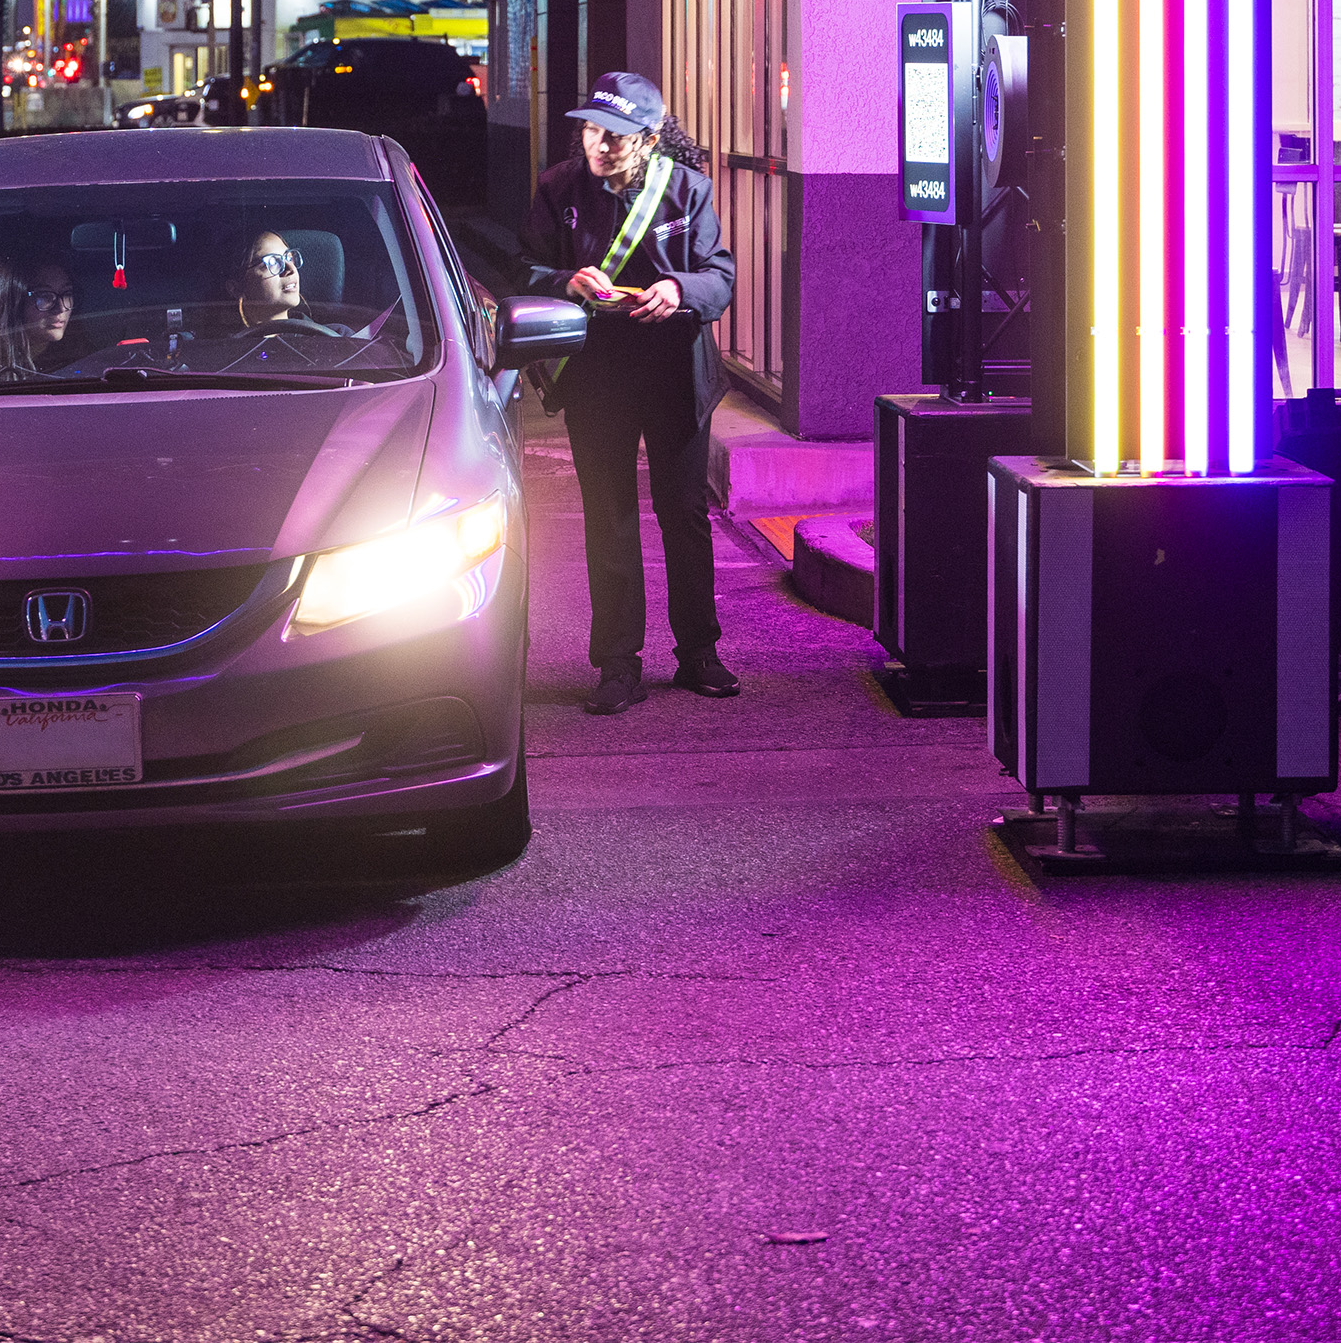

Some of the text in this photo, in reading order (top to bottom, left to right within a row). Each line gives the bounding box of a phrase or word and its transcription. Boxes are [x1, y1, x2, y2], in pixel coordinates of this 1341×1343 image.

[908, 29, 944, 47] w43484
[910, 180, 945, 199] w43484
[10, 700, 99, 714] HONDA
[6, 710, 108, 732] California
[30, 768, 136, 785] ANGELES
